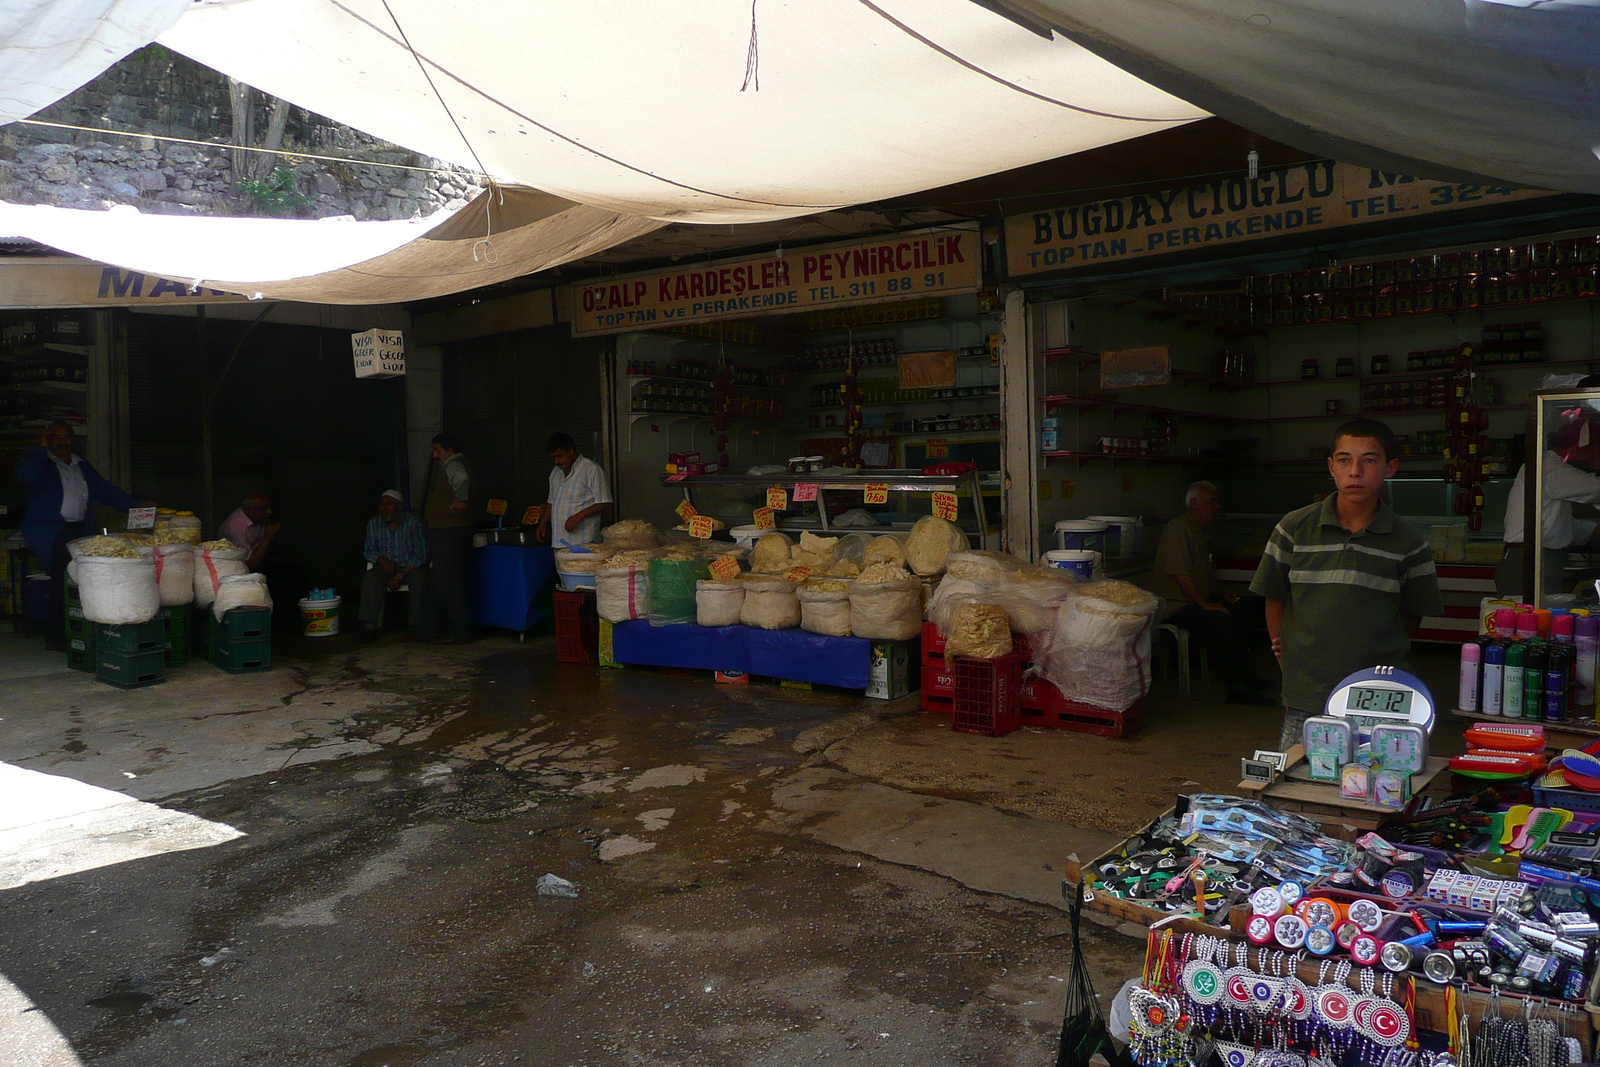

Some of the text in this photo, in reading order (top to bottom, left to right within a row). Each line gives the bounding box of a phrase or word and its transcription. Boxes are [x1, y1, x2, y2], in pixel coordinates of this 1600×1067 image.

[1026, 238, 1127, 268] TOPTAN
[1148, 206, 1323, 250] PERAKENDE
[583, 281, 647, 312] ÖZALP
[659, 260, 790, 302] KARDEŞLER
[596, 308, 657, 326] TOPTAN
[693, 290, 798, 316] PERAKENDE
[808, 286, 845, 301] TEL.
[849, 281, 875, 297] 311
[887, 276, 912, 292] 88
[924, 272, 945, 287] 91
[355, 336, 373, 347] VISA
[378, 335, 402, 347] VISA
[1356, 690, 1405, 712] 12:12
[1437, 870, 1457, 878] 502
[1480, 880, 1500, 888] 502
[1504, 881, 1525, 890] 502
